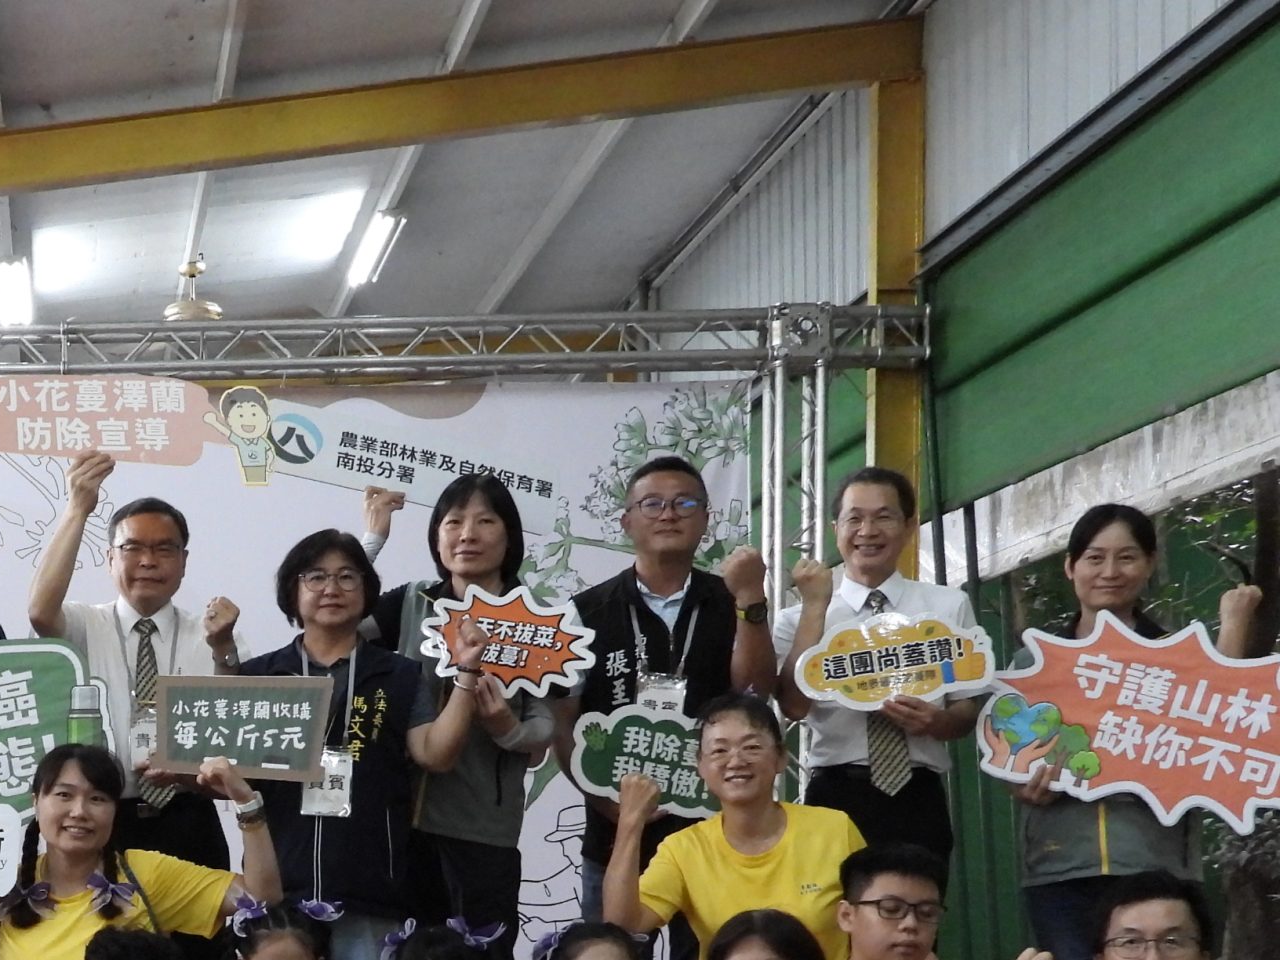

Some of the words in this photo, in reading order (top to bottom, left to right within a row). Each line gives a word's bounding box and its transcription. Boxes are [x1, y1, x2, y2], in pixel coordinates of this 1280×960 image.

[16, 417, 169, 451] 防除宣導
[336, 451, 415, 484] 南投分署
[339, 431, 553, 499] 農業部林業及自然保育署
[823, 637, 964, 680] 這團尚蓋讚!
[172, 699, 312, 721] 小花蔓澤蘭收購
[1073, 653, 1277, 740] 守護山林
[174, 721, 306, 750] 每公斤5元
[1092, 710, 1280, 796] 缺你不可
